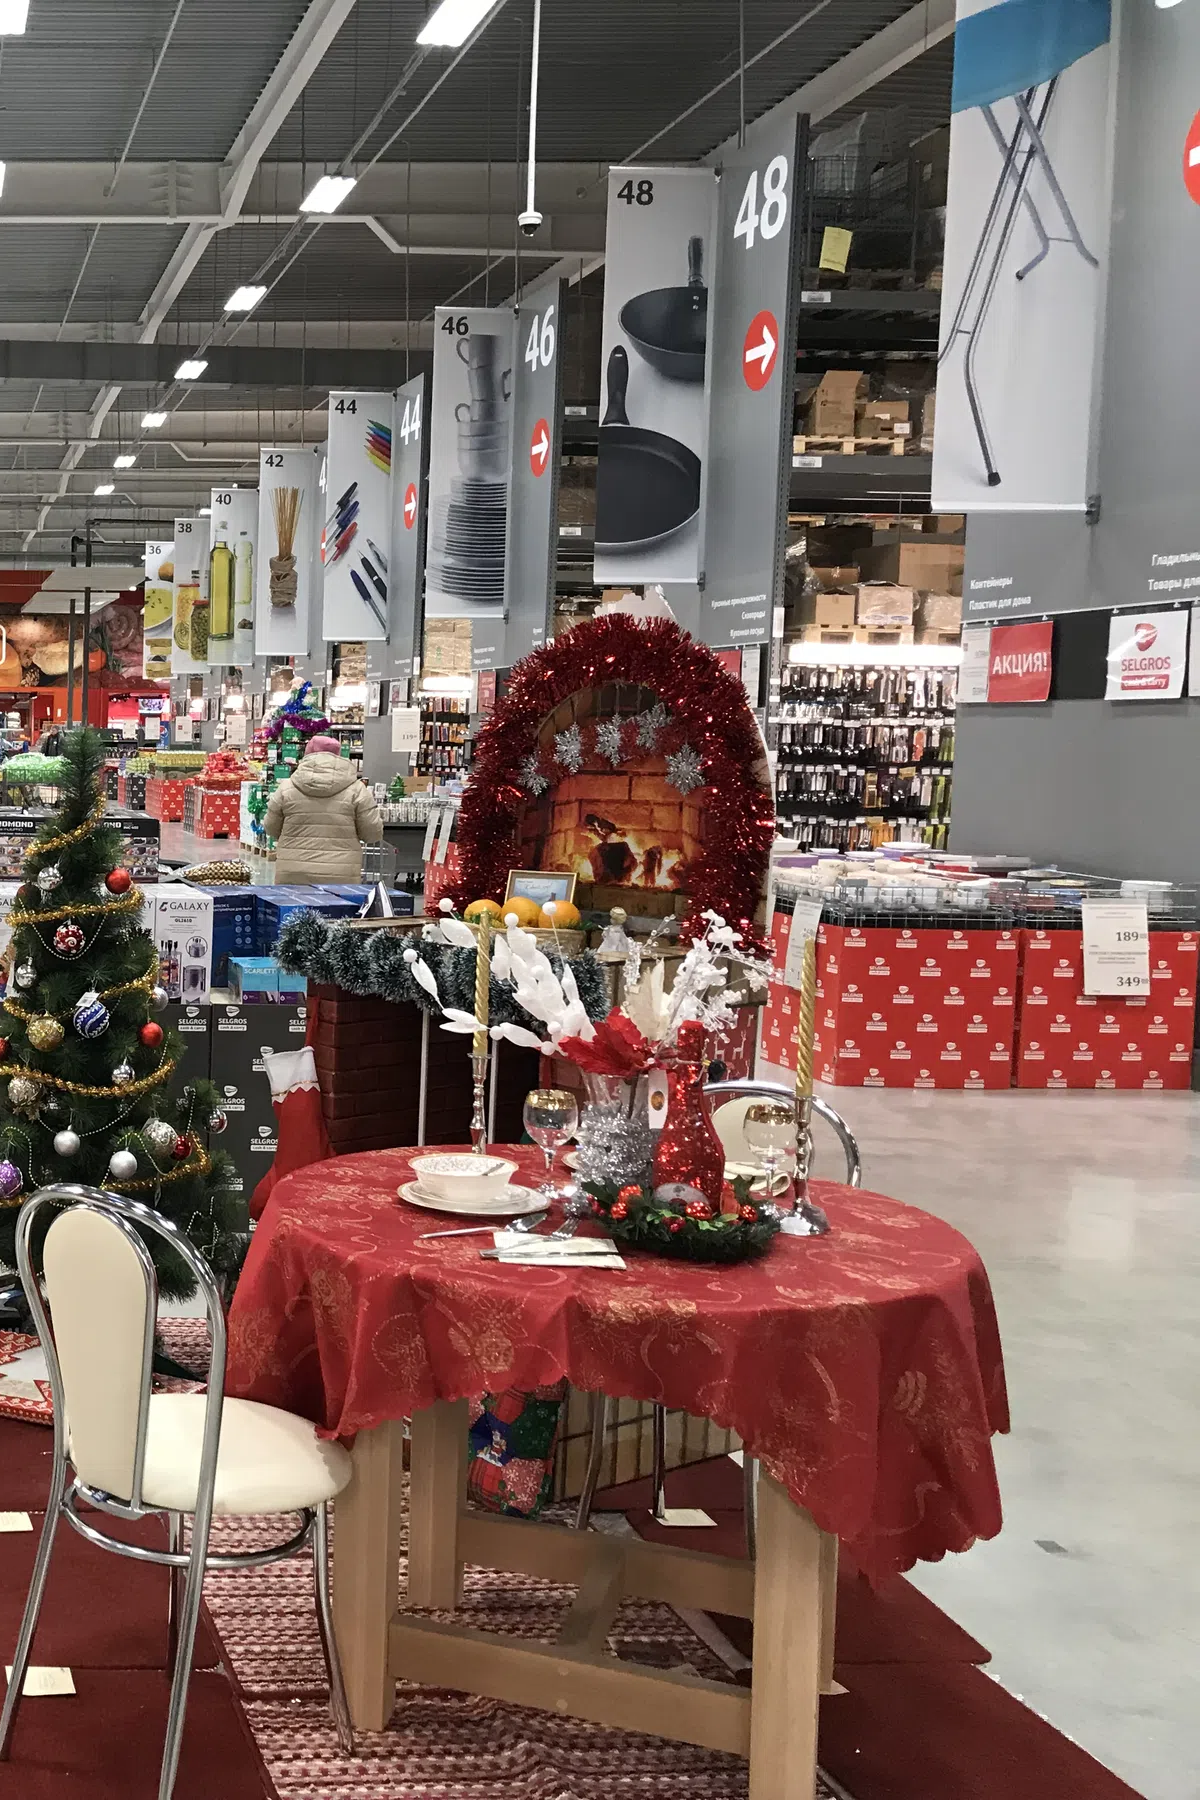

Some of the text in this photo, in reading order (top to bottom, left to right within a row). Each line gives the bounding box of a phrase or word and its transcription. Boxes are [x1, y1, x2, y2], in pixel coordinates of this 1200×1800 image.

[617, 179, 654, 206] 48
[733, 154, 788, 249] 48
[441, 315, 469, 335] 46
[524, 304, 555, 372] 46
[334, 398, 358, 415] 44
[400, 393, 421, 445] 44
[264, 454, 284, 468] 42
[318, 456, 328, 494] 4
[215, 493, 232, 505] 40
[177, 522, 193, 533] 38
[148, 545, 162, 555] 36
[1148, 578, 1182, 591] Товары
[991, 652, 1048, 677] АКЦИЯ!
[1121, 656, 1171, 672] SELGROS
[169, 901, 210, 912] GALAXY
[1116, 931, 1139, 942] 189
[1116, 976, 1141, 987] 349
